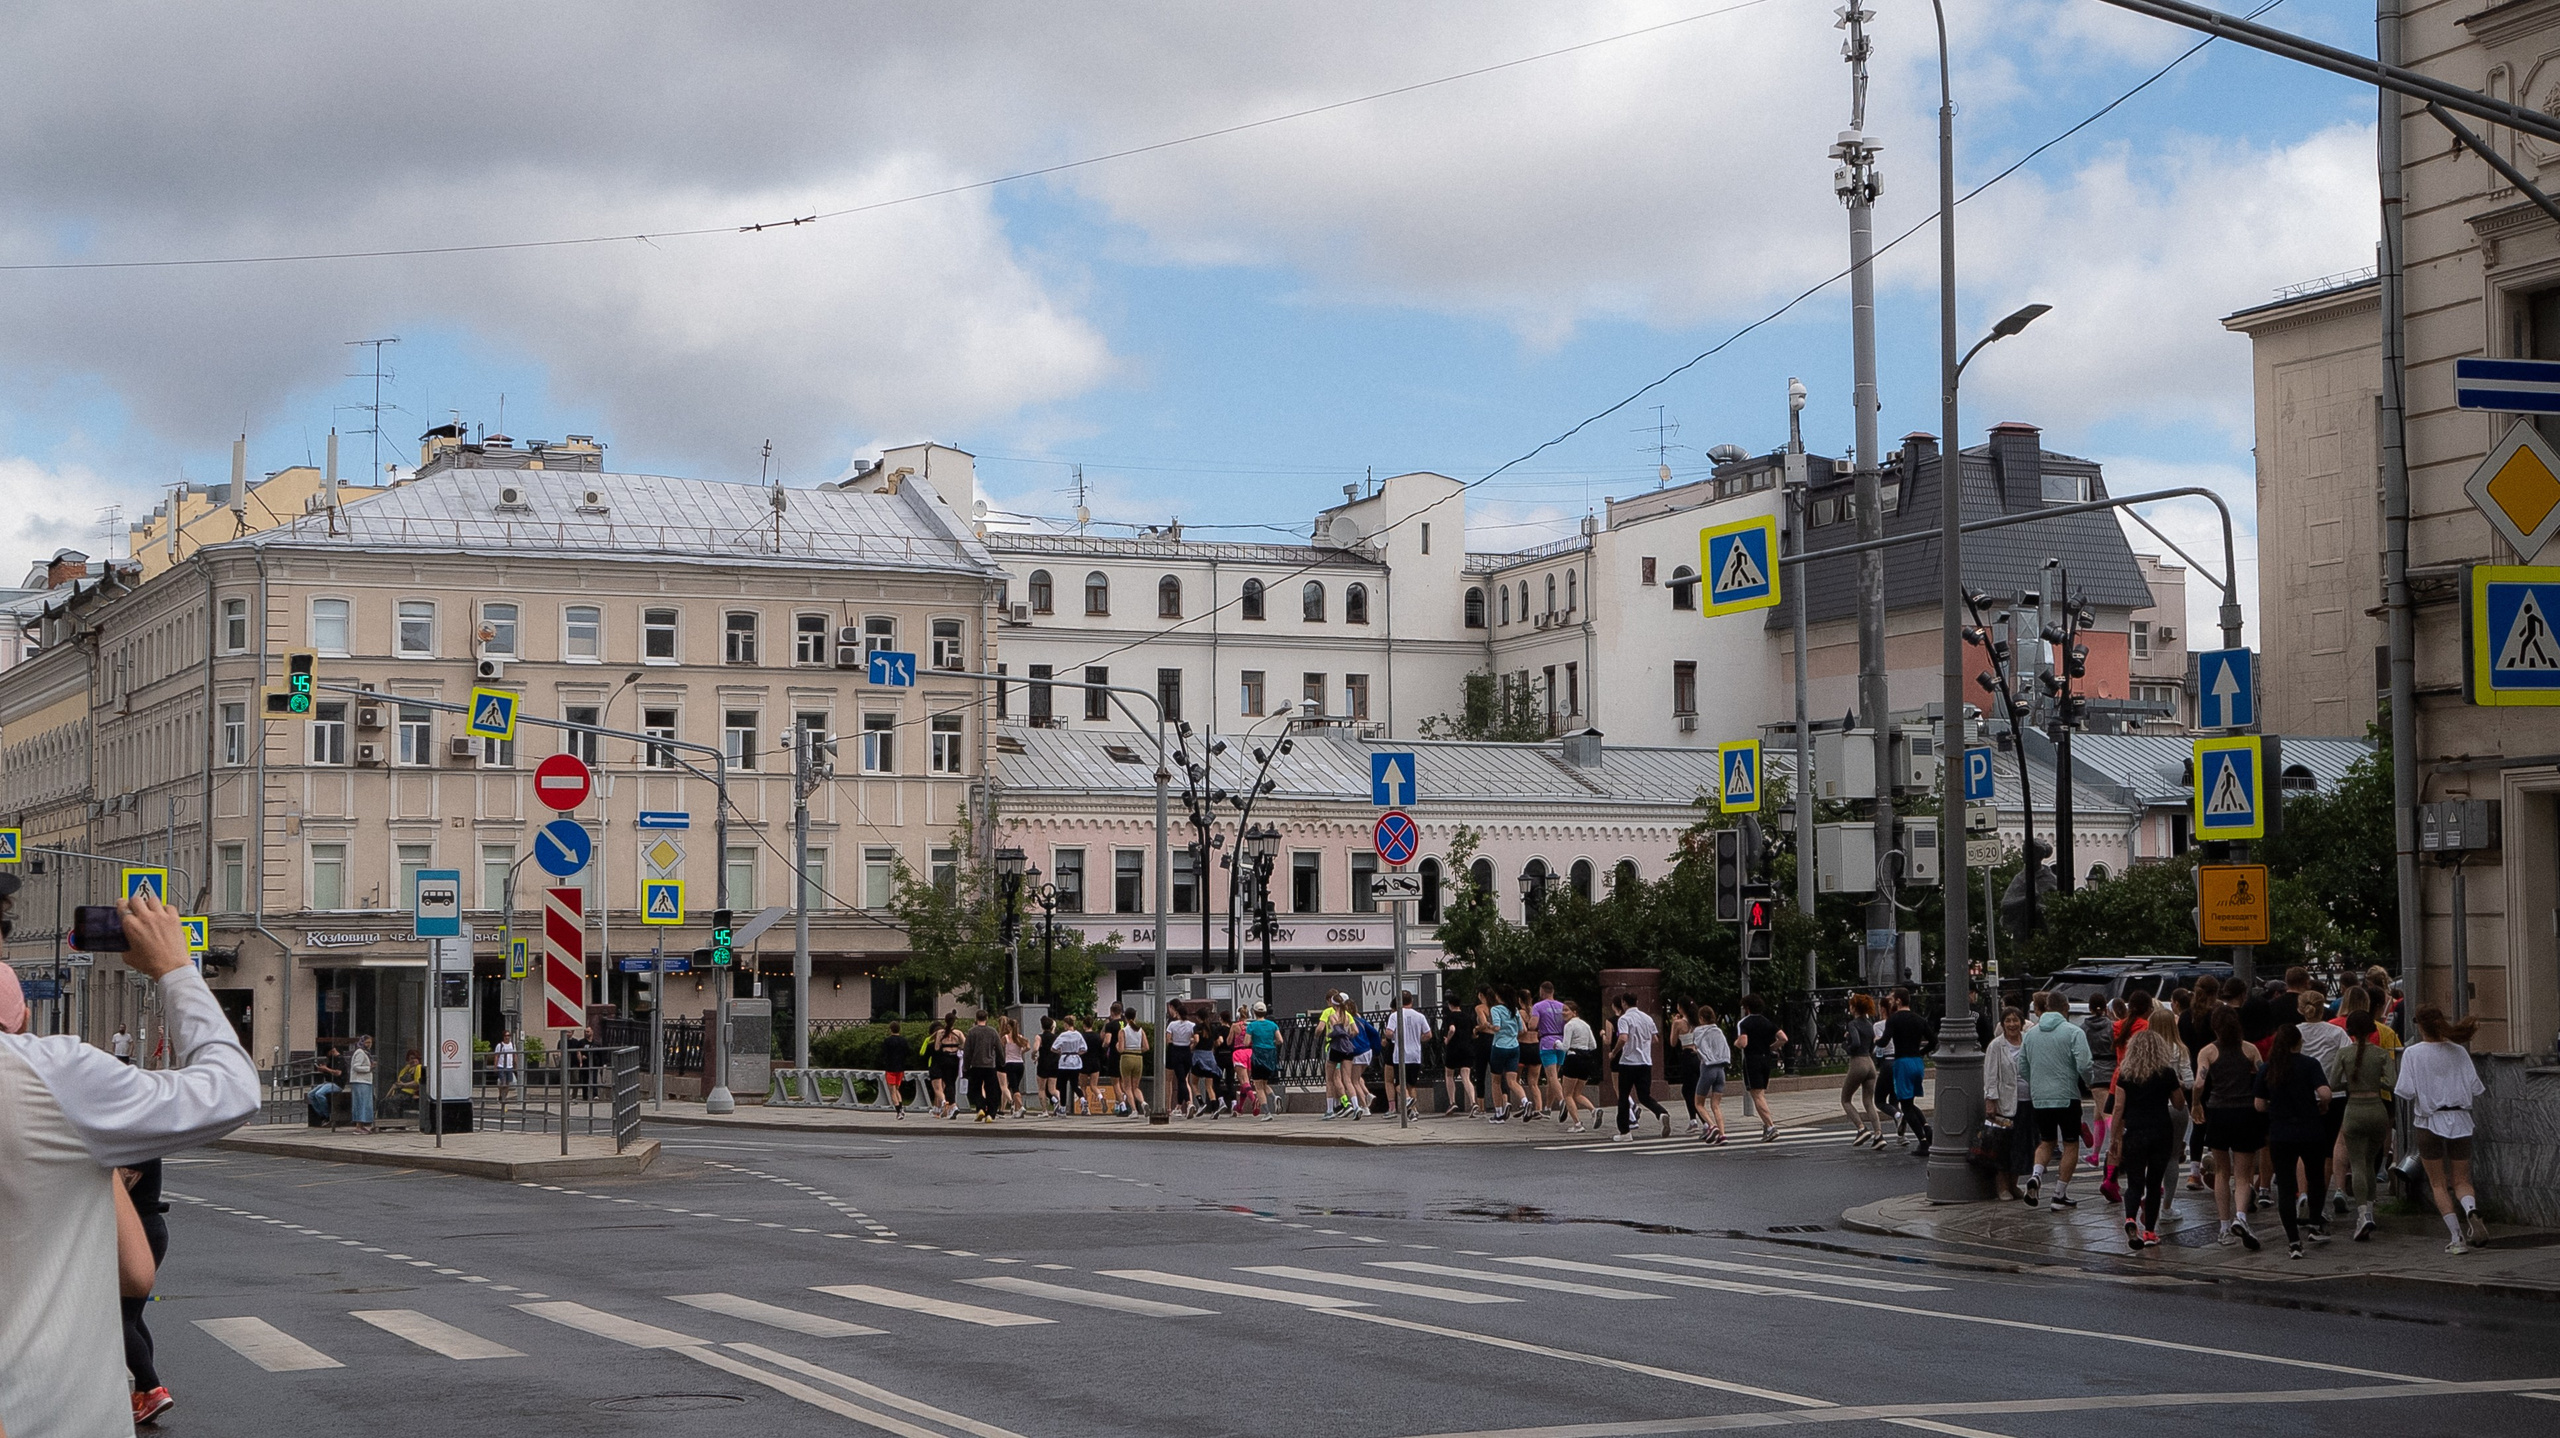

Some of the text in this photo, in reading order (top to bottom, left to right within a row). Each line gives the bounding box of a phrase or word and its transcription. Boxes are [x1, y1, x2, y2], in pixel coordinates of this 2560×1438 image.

[292, 675, 310, 693] 45
[1969, 753, 1988, 795] P
[1976, 849, 1984, 858] 15
[1985, 847, 1997, 858] 20
[2211, 913, 2258, 922] Переходите
[306, 931, 381, 947] Козловица
[714, 929, 731, 946] 45
[1326, 928, 1366, 942] OSSU
[1363, 980, 1392, 996] WC
